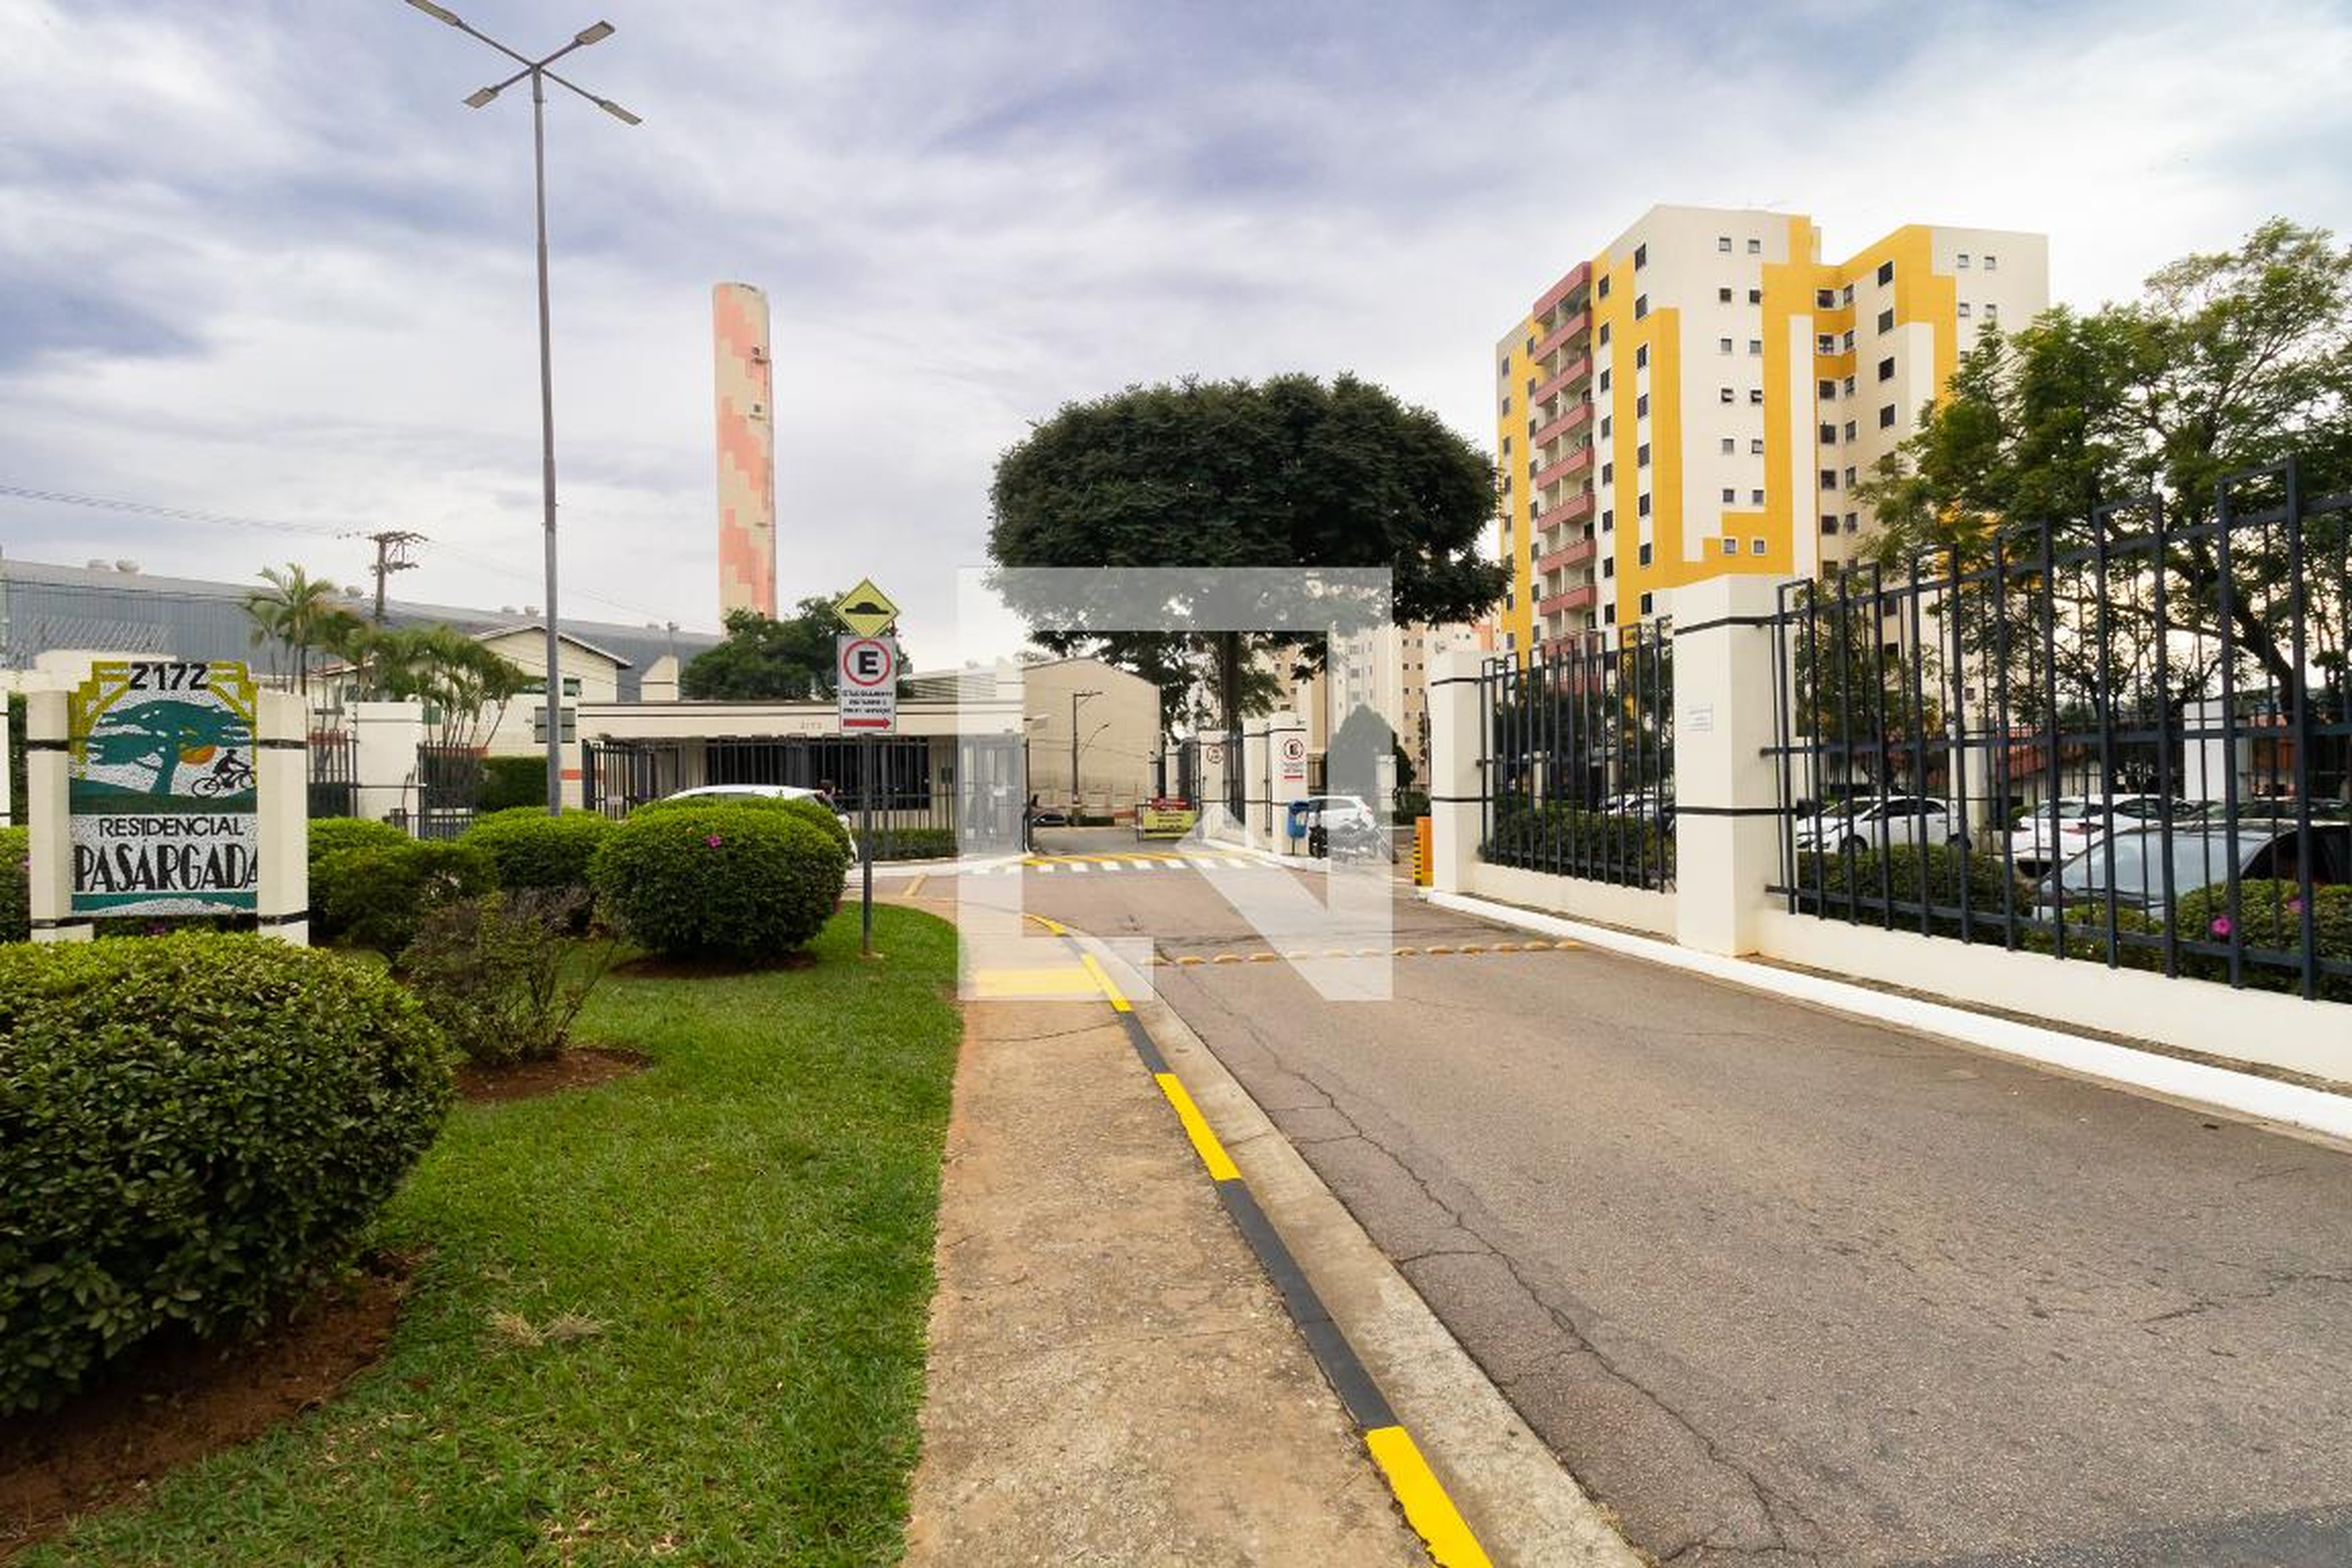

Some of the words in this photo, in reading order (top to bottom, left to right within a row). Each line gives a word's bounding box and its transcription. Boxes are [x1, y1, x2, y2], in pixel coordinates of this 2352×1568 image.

[859, 651, 878, 674] E
[130, 662, 207, 690] 2172
[99, 816, 244, 837] RESIDENCIAL
